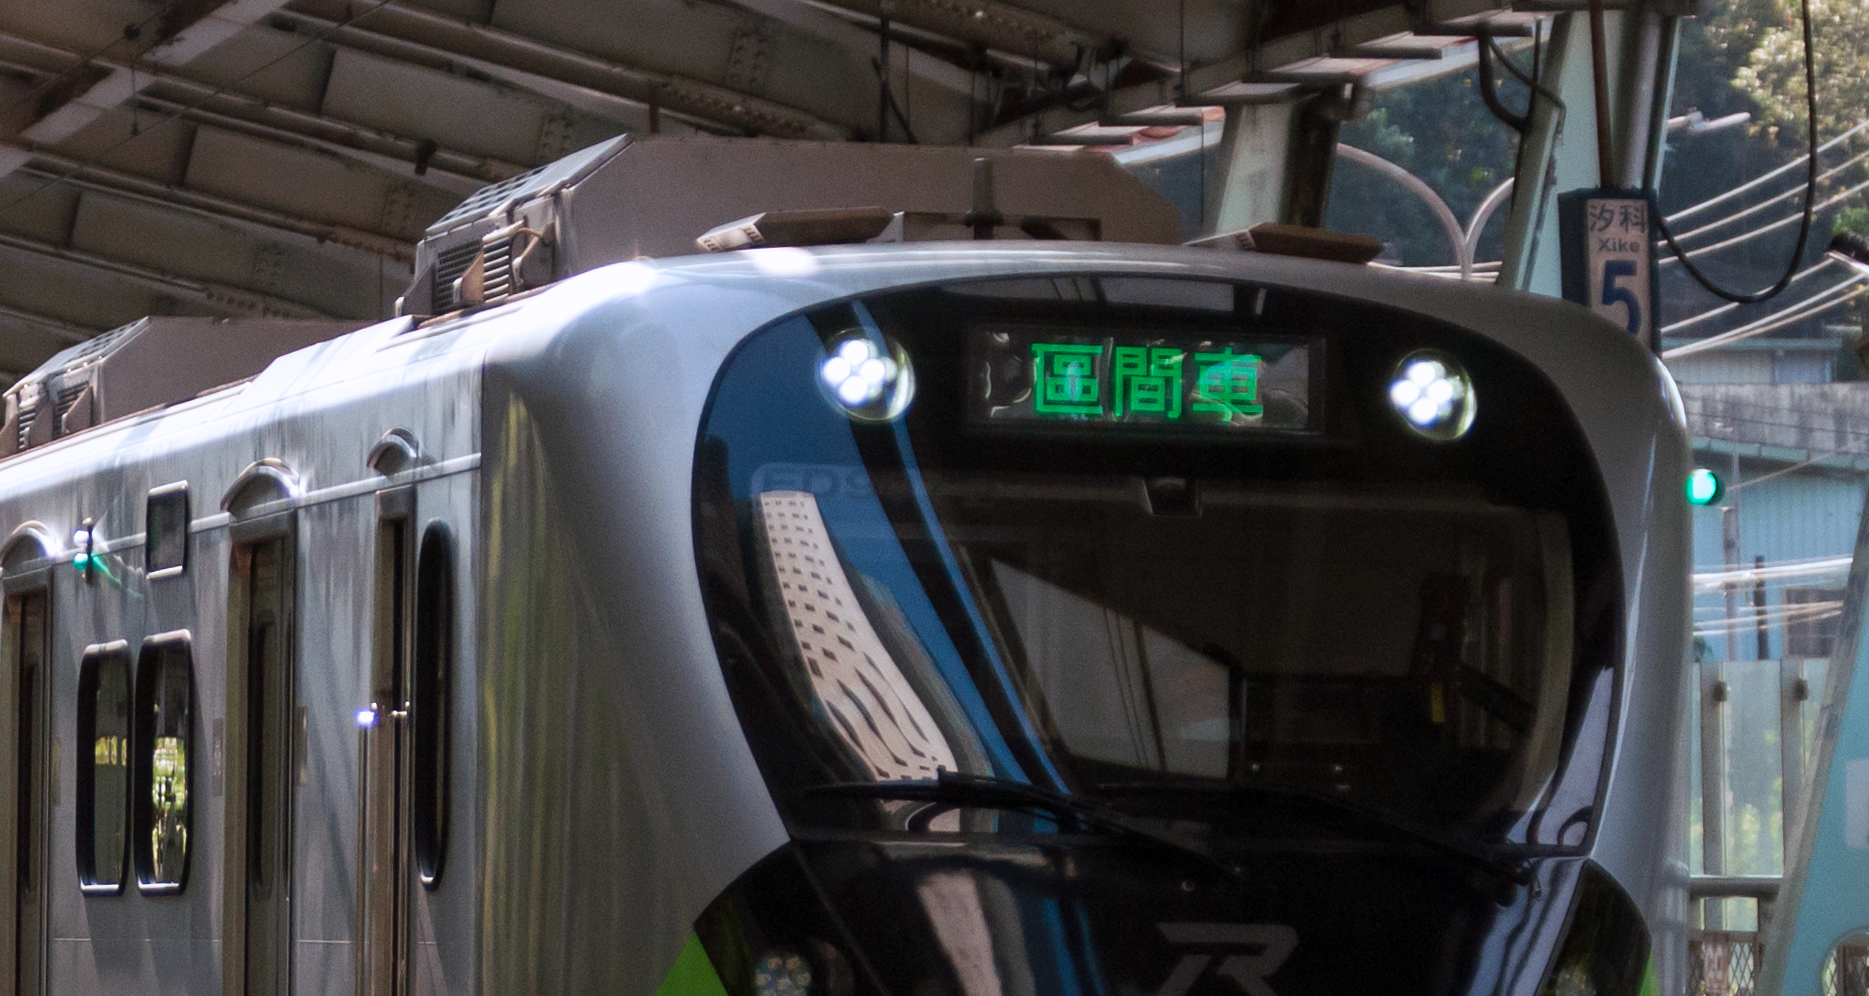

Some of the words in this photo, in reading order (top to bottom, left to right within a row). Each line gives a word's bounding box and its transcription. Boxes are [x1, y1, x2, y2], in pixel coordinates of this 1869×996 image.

[1589, 203, 1649, 233] 汐科
[1598, 237, 1641, 253] Xike
[1601, 260, 1642, 337] 5
[1030, 341, 1266, 424] 區間車
